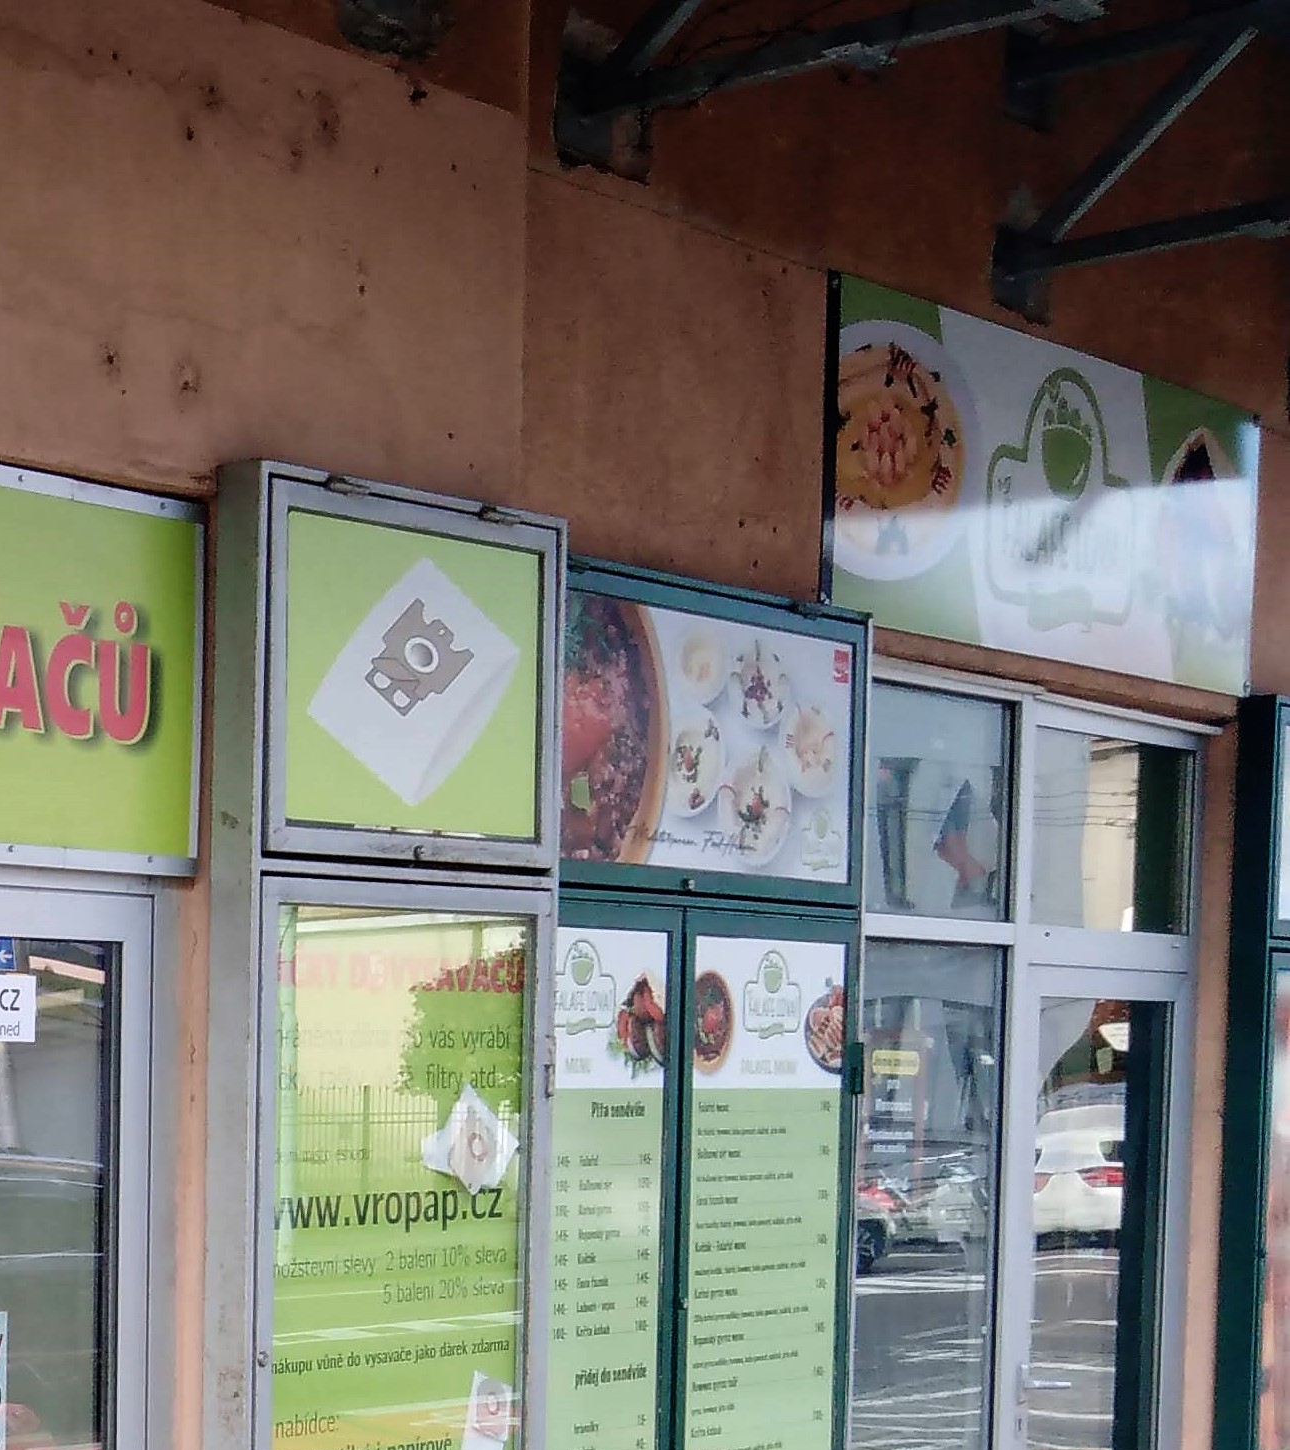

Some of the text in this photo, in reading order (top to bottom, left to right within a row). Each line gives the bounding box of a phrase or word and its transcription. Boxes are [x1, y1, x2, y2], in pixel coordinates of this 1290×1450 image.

[429, 1024, 455, 1048] vás
[462, 1023, 511, 1055] vyrábí
[426, 1063, 463, 1094] filtry
[274, 1244, 508, 1278] nožstevní slevy 2 balení 10% sleva
[383, 1276, 505, 1304] 5 balení 20% sleva
[271, 1337, 510, 1376] nákupu vůně do vysavače jako dárek zdarma
[601, 1367, 611, 1383] do
[275, 1411, 340, 1439] nabídce:
